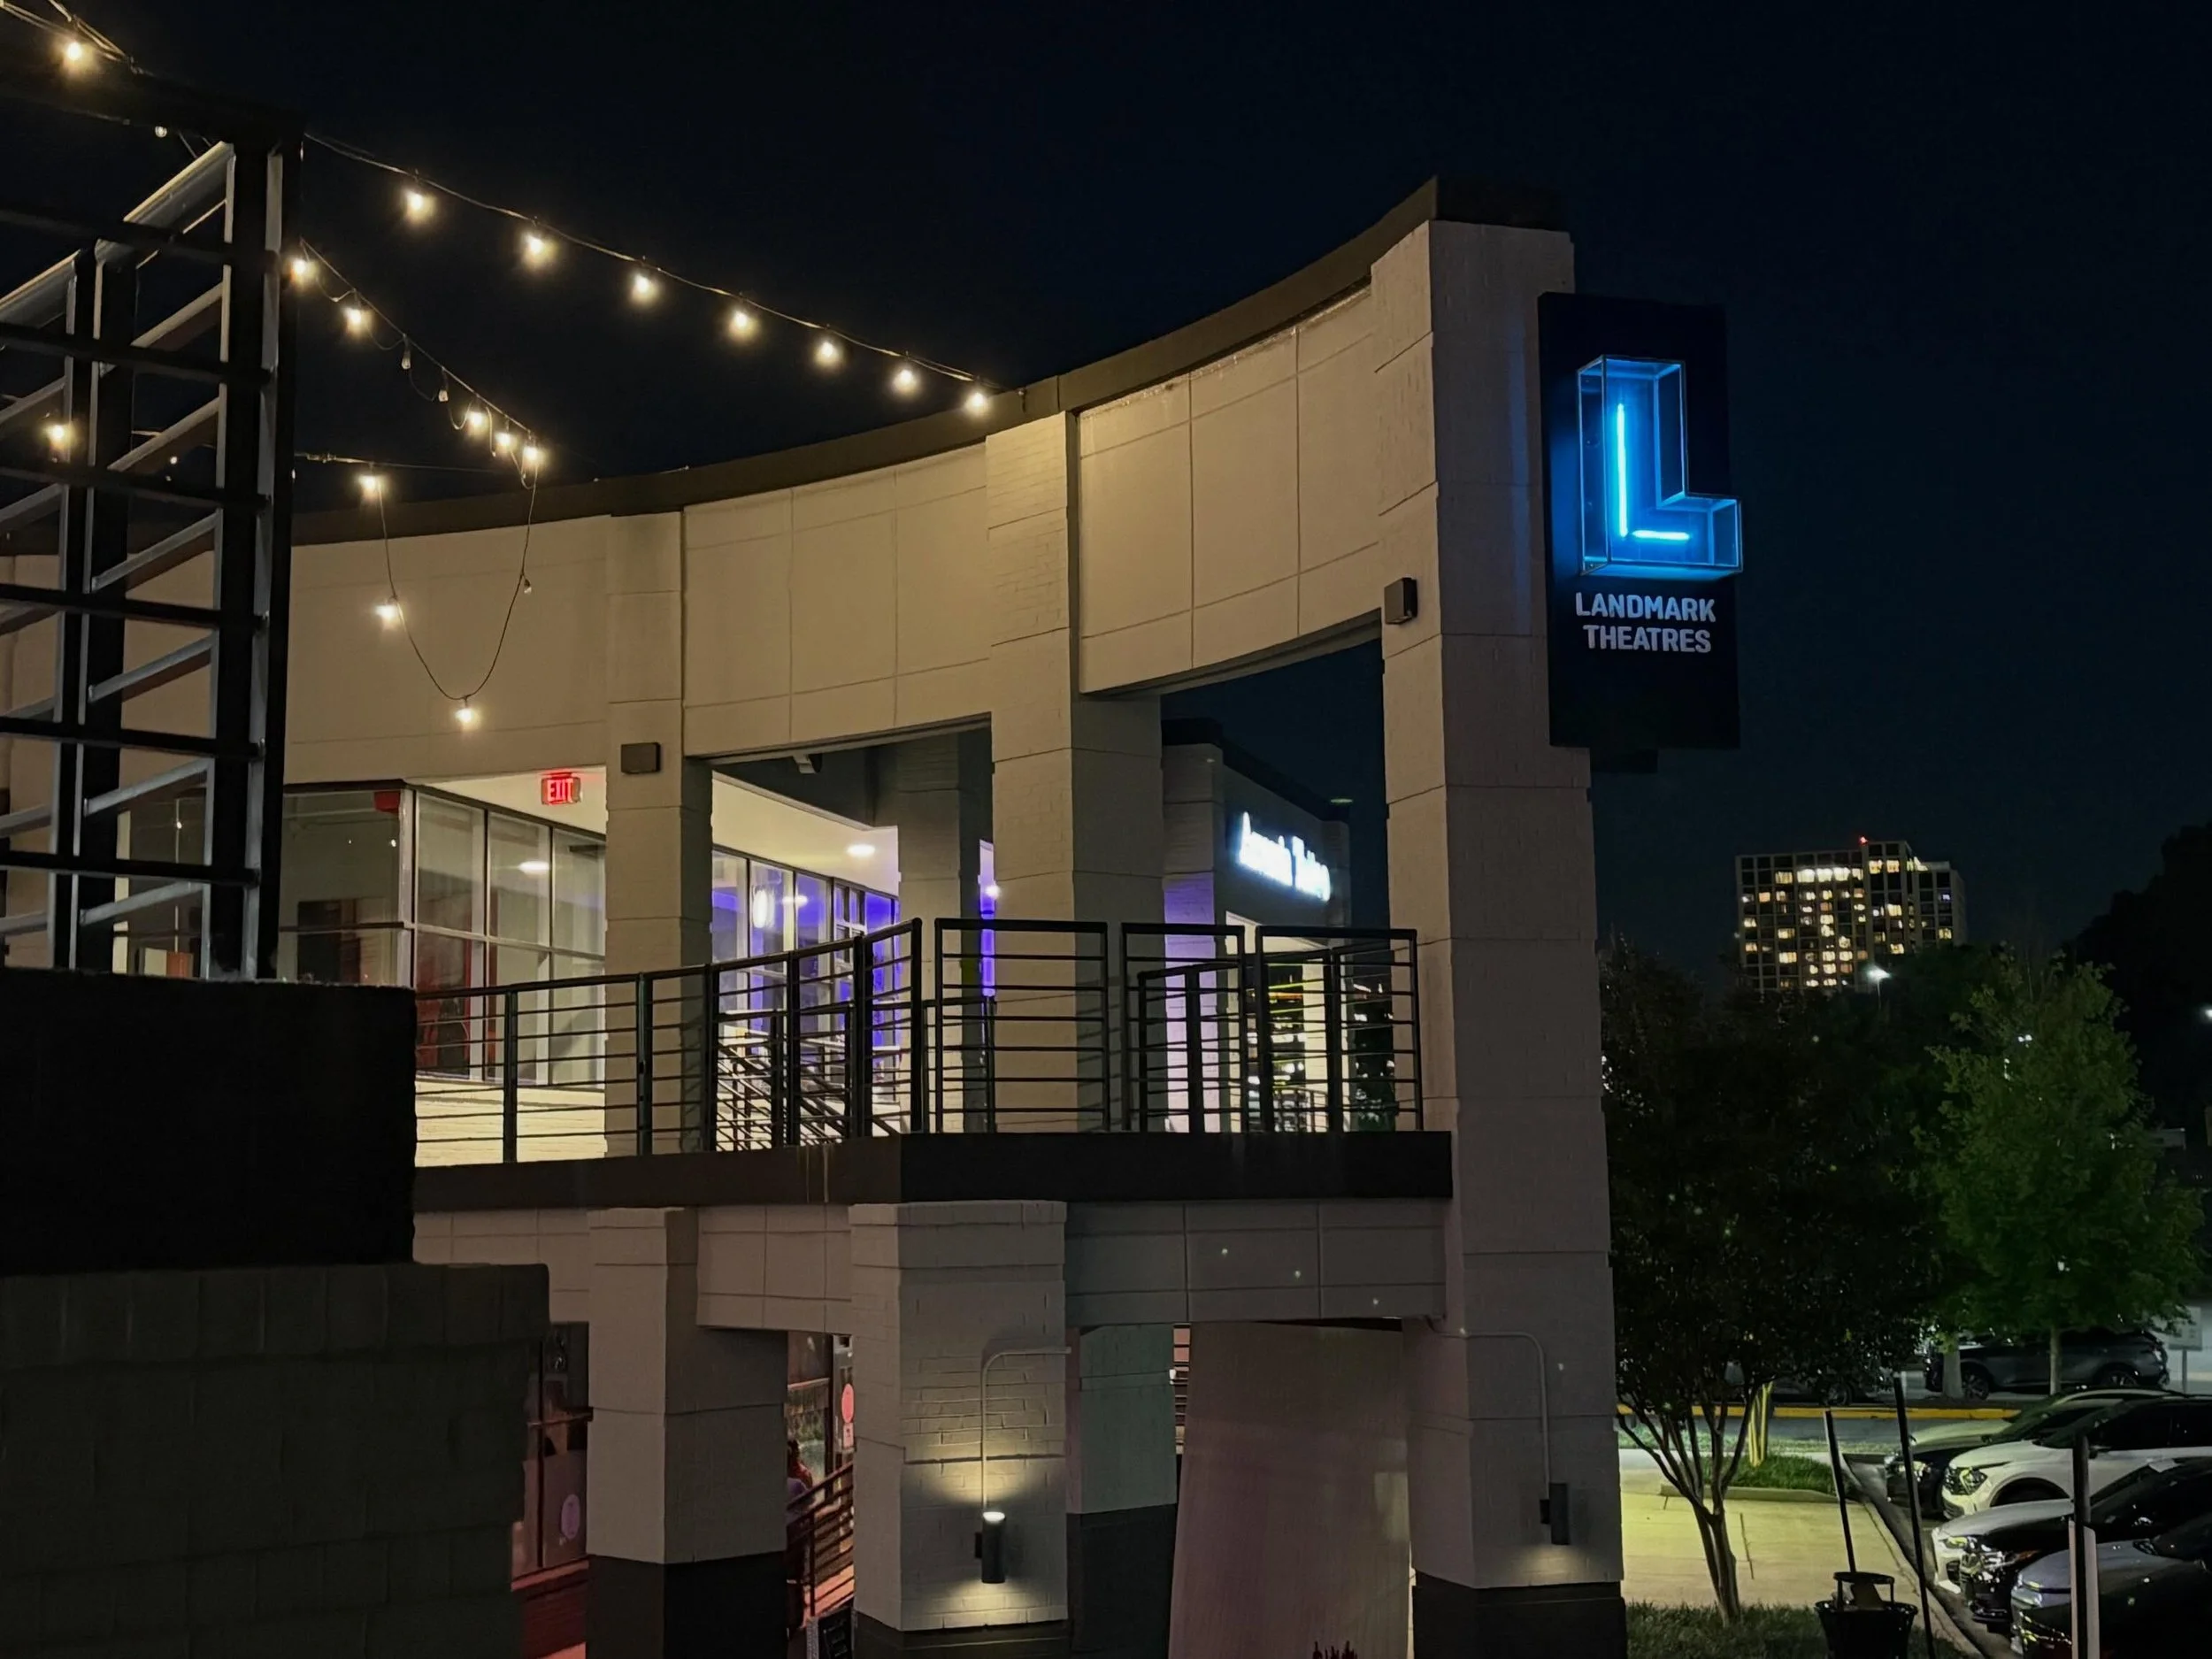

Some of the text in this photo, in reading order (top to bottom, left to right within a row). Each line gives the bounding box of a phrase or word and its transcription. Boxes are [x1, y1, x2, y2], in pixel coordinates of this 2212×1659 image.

[1577, 355, 1743, 576] L
[1575, 592, 1717, 623] LANDMARK
[1582, 624, 1712, 654] THEATRES
[546, 778, 574, 803] EXIT
